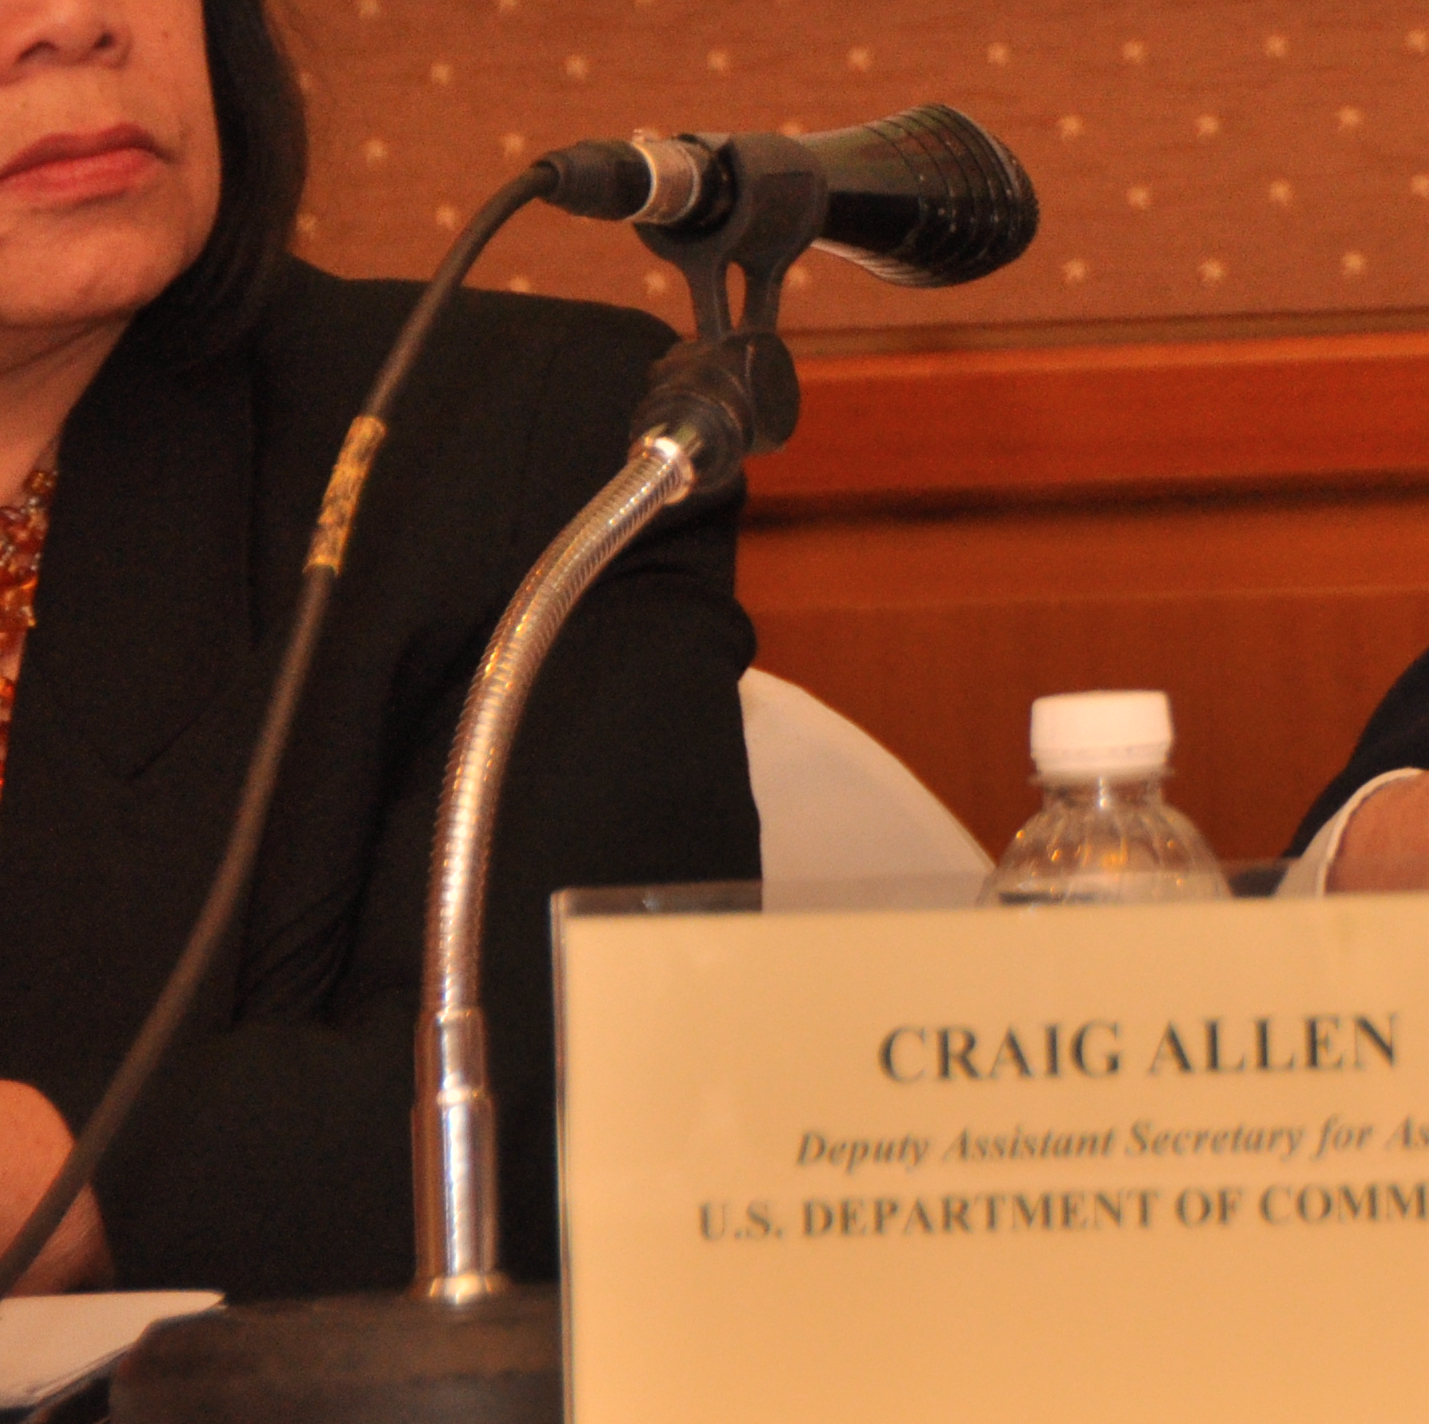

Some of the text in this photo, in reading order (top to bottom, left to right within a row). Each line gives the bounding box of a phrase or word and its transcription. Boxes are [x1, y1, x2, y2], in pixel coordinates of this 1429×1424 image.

[876, 1013, 1401, 1085] CRAIG ALLEN
[794, 1129, 931, 1174] Deputy
[942, 1126, 1117, 1164] Assistant
[1124, 1118, 1307, 1164] Secretary
[1312, 1114, 1375, 1160] for
[696, 1201, 785, 1244] U.S.
[800, 1188, 1159, 1239] DEPARTMENT
[1173, 1186, 1241, 1228] OF
